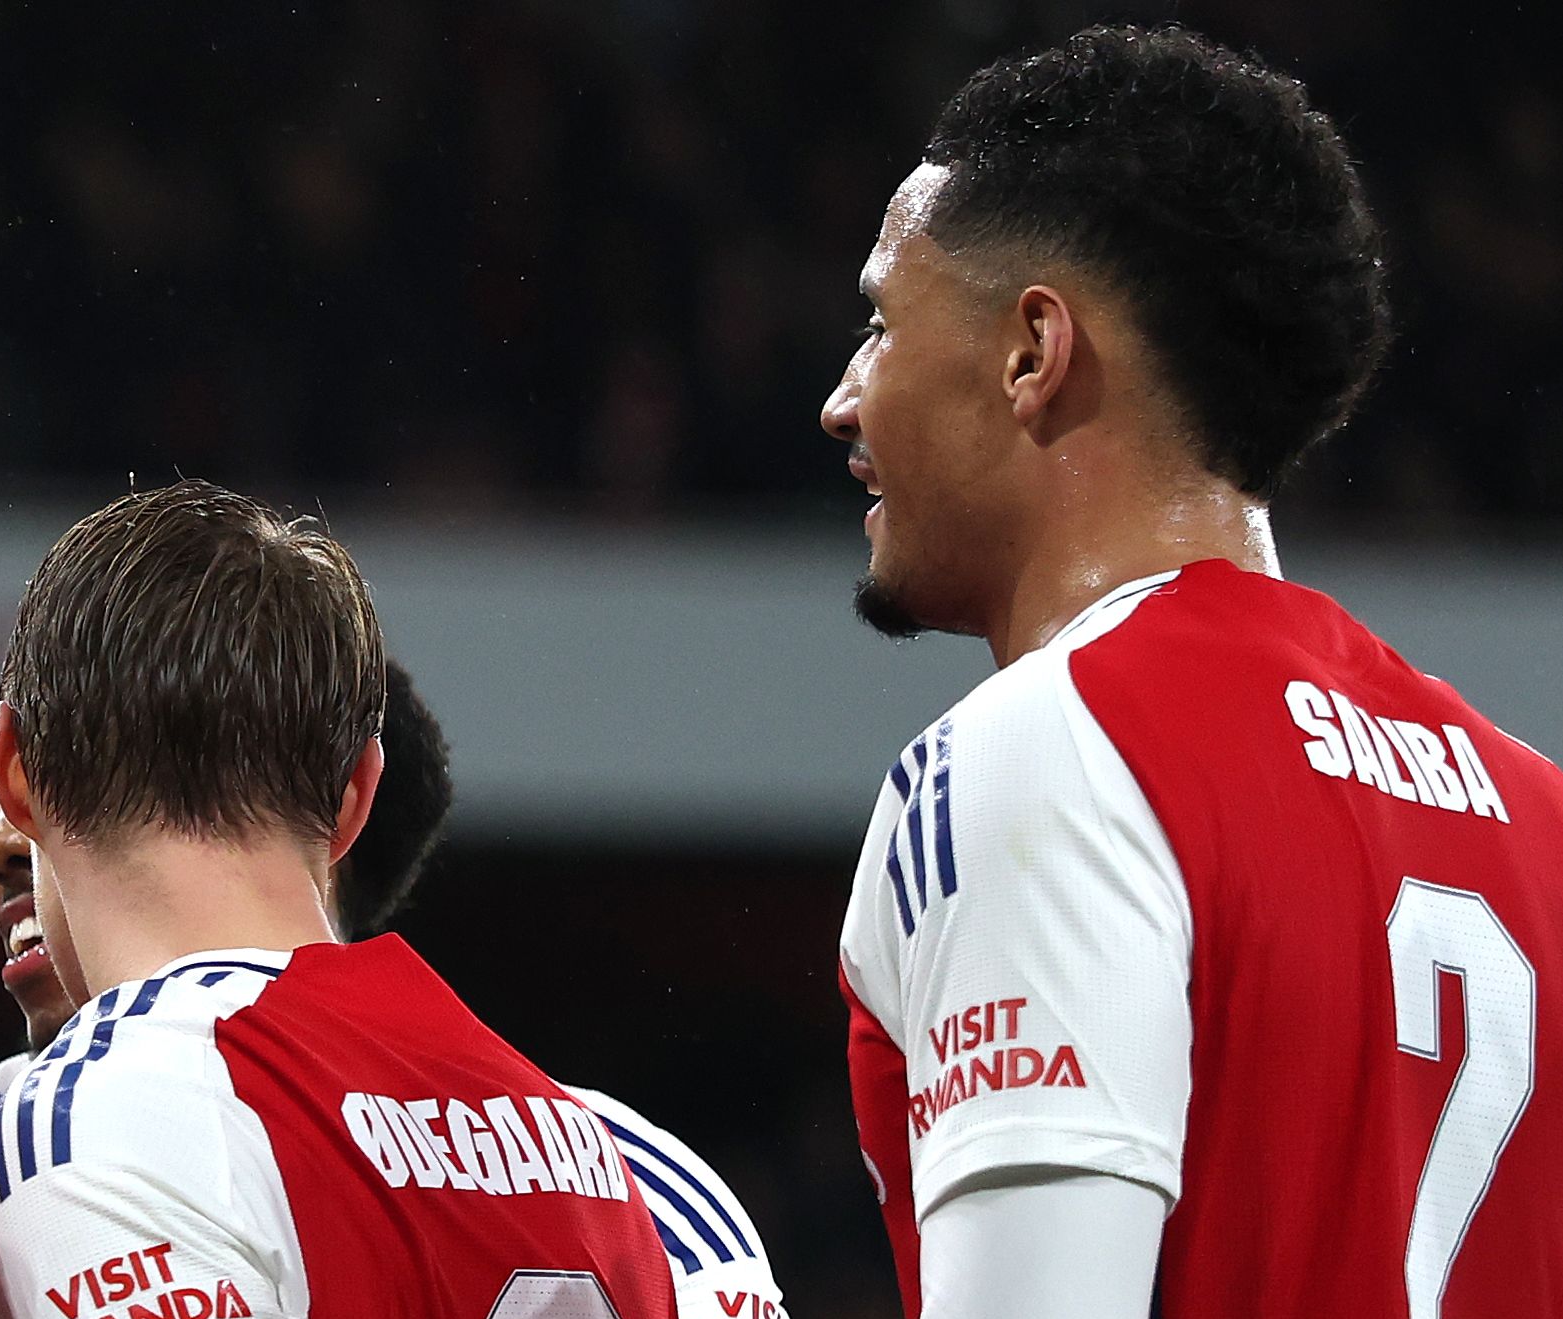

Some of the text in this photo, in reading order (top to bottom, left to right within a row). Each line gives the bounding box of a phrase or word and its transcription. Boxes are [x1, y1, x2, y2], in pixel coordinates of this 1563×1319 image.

[1283, 680, 1511, 824] SALIBA
[928, 997, 1027, 1065] VISIT
[909, 1045, 1087, 1140] RWANDA
[340, 1092, 629, 1203] ØDEGAARD
